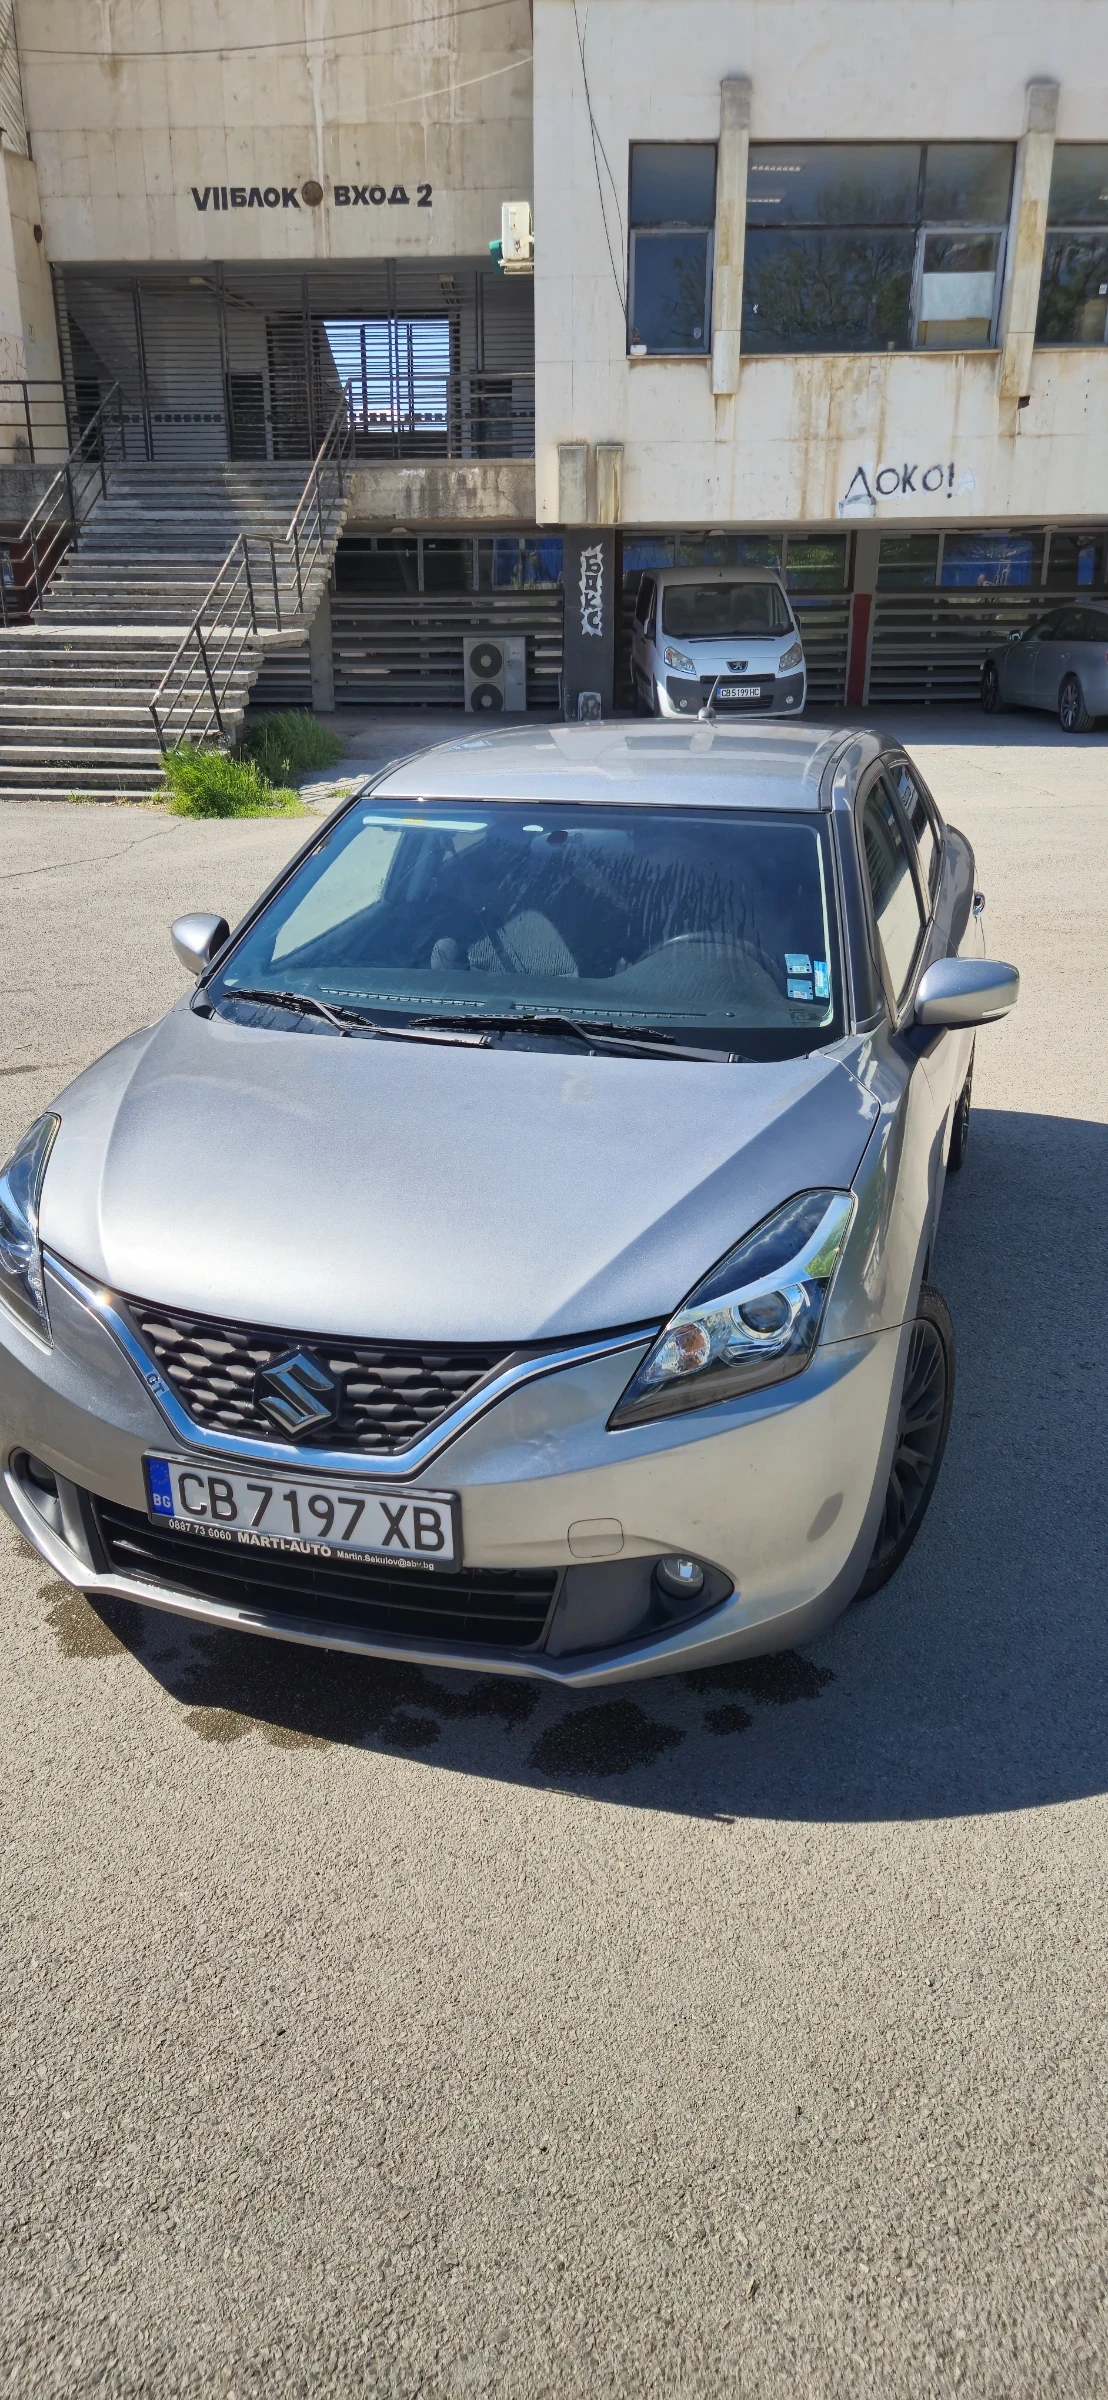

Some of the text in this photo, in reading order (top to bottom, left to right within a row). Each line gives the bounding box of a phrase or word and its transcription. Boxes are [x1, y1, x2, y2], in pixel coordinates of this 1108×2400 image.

[333, 184, 411, 208] ВХОД
[416, 183, 434, 209] 2
[146, 1372, 166, 1394] GT
[152, 1493, 172, 1509] BG
[168, 1519, 191, 1532] 0887
[193, 1524, 206, 1536] 73
[208, 1529, 232, 1541] 6060
[237, 1531, 332, 1558] MARTI-AUTO
